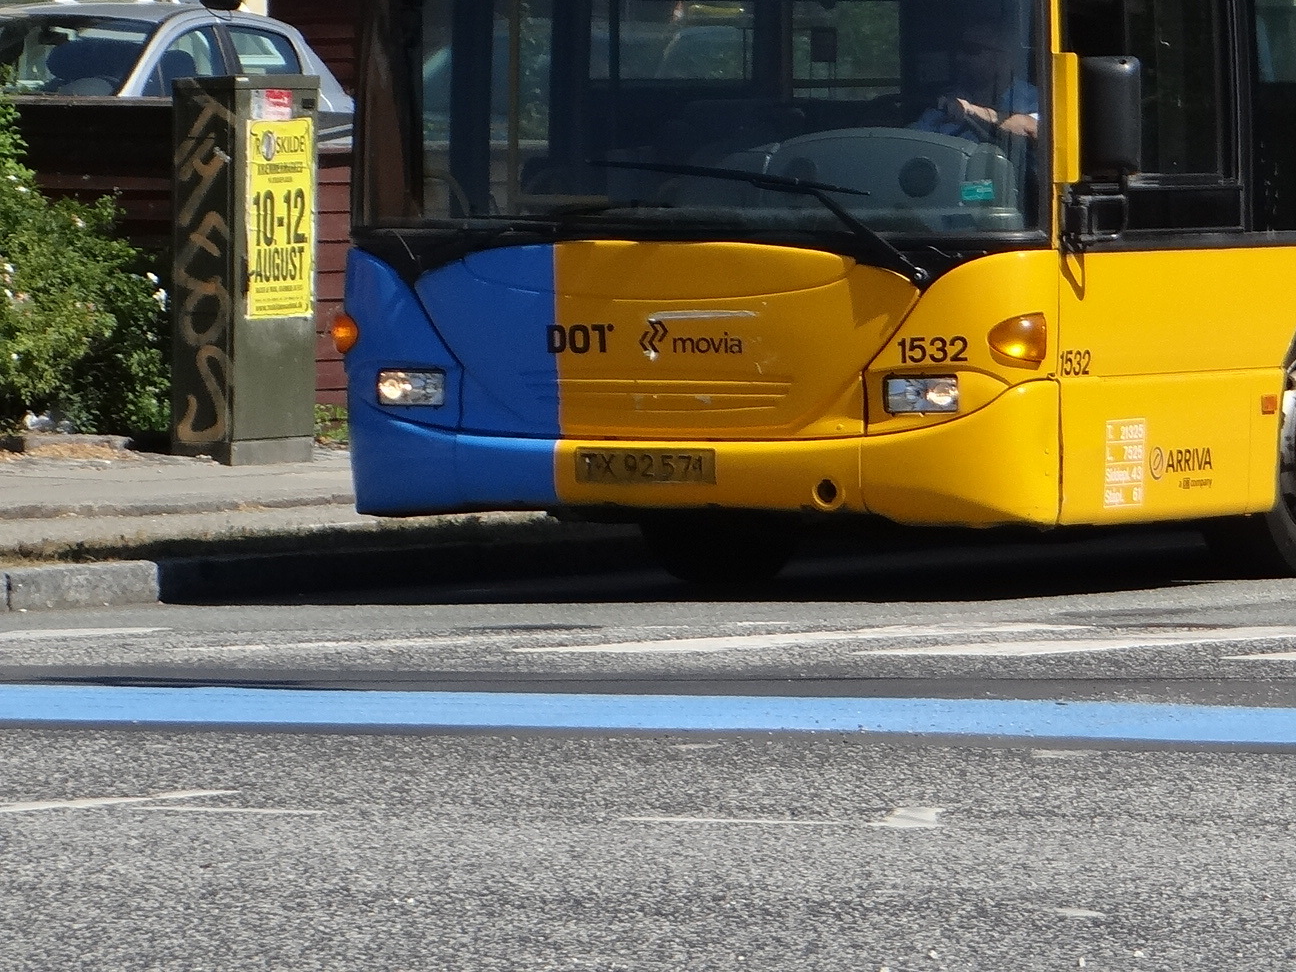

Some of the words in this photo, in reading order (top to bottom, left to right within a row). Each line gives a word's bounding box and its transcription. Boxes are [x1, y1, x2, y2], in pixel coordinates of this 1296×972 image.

[254, 245, 305, 284] AUGUST
[672, 332, 743, 355] movia
[897, 335, 968, 364] 1532
[1060, 349, 1091, 377] 1532
[1165, 446, 1213, 474] ARRIVA
[1191, 478, 1213, 489] company
